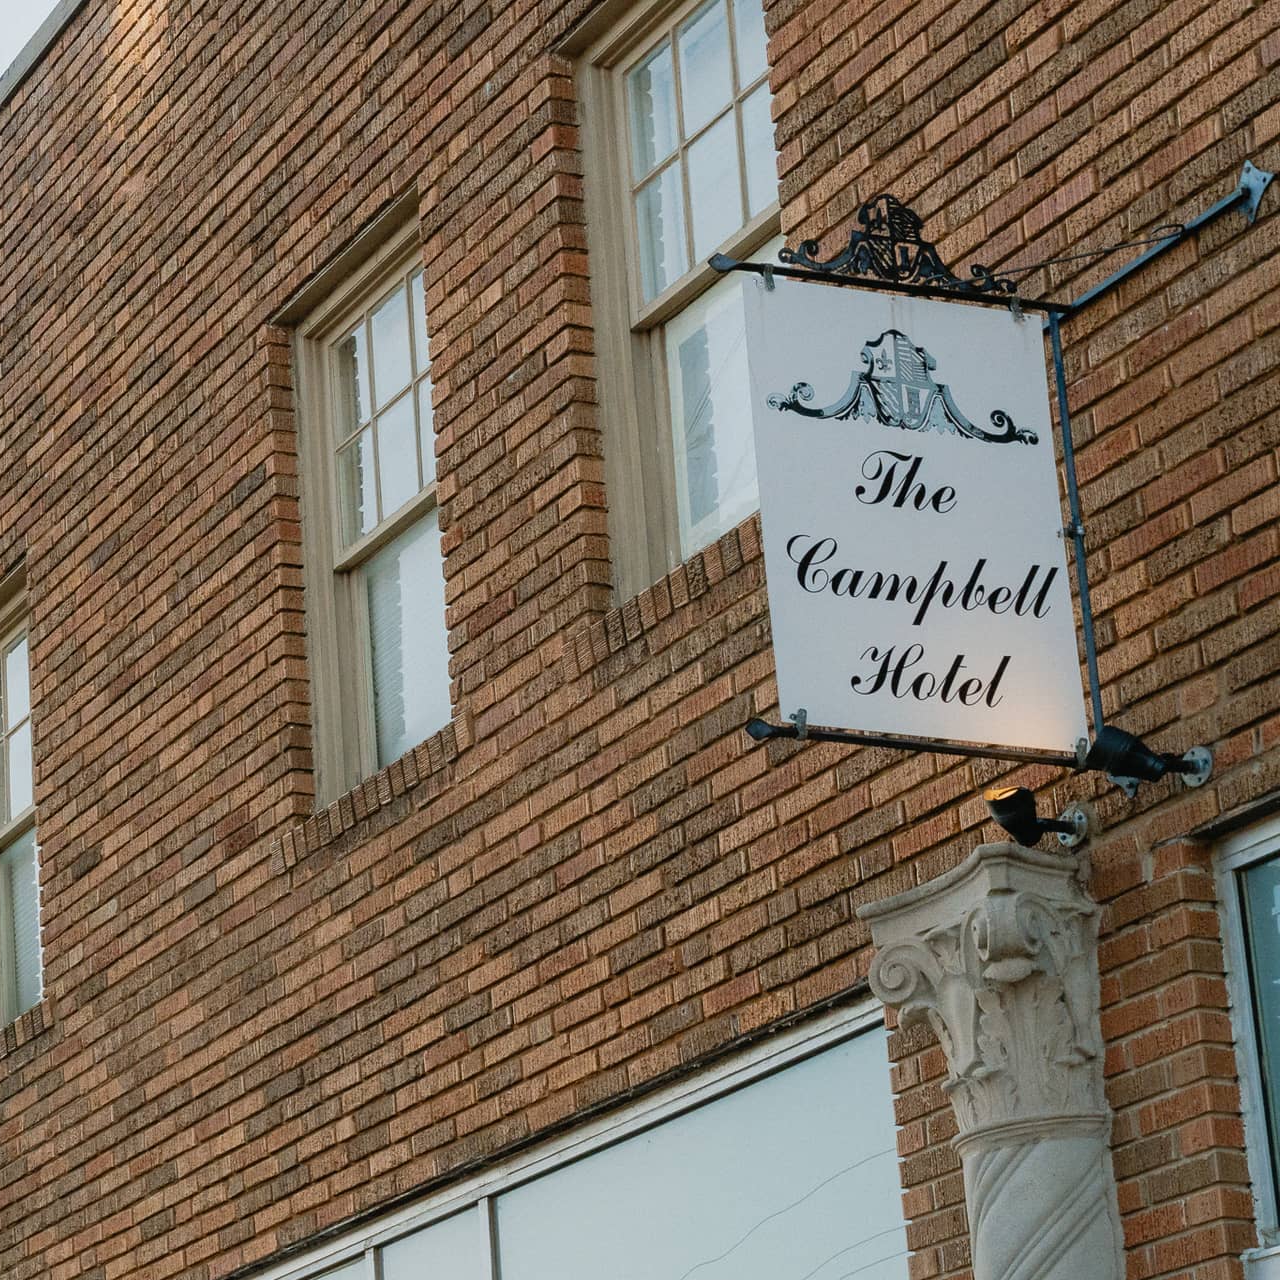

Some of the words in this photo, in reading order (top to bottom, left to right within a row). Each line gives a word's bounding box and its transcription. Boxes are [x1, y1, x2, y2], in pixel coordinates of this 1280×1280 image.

[855, 450, 958, 514] The
[786, 534, 1059, 626] Campbell
[850, 643, 1012, 708] Hotel
